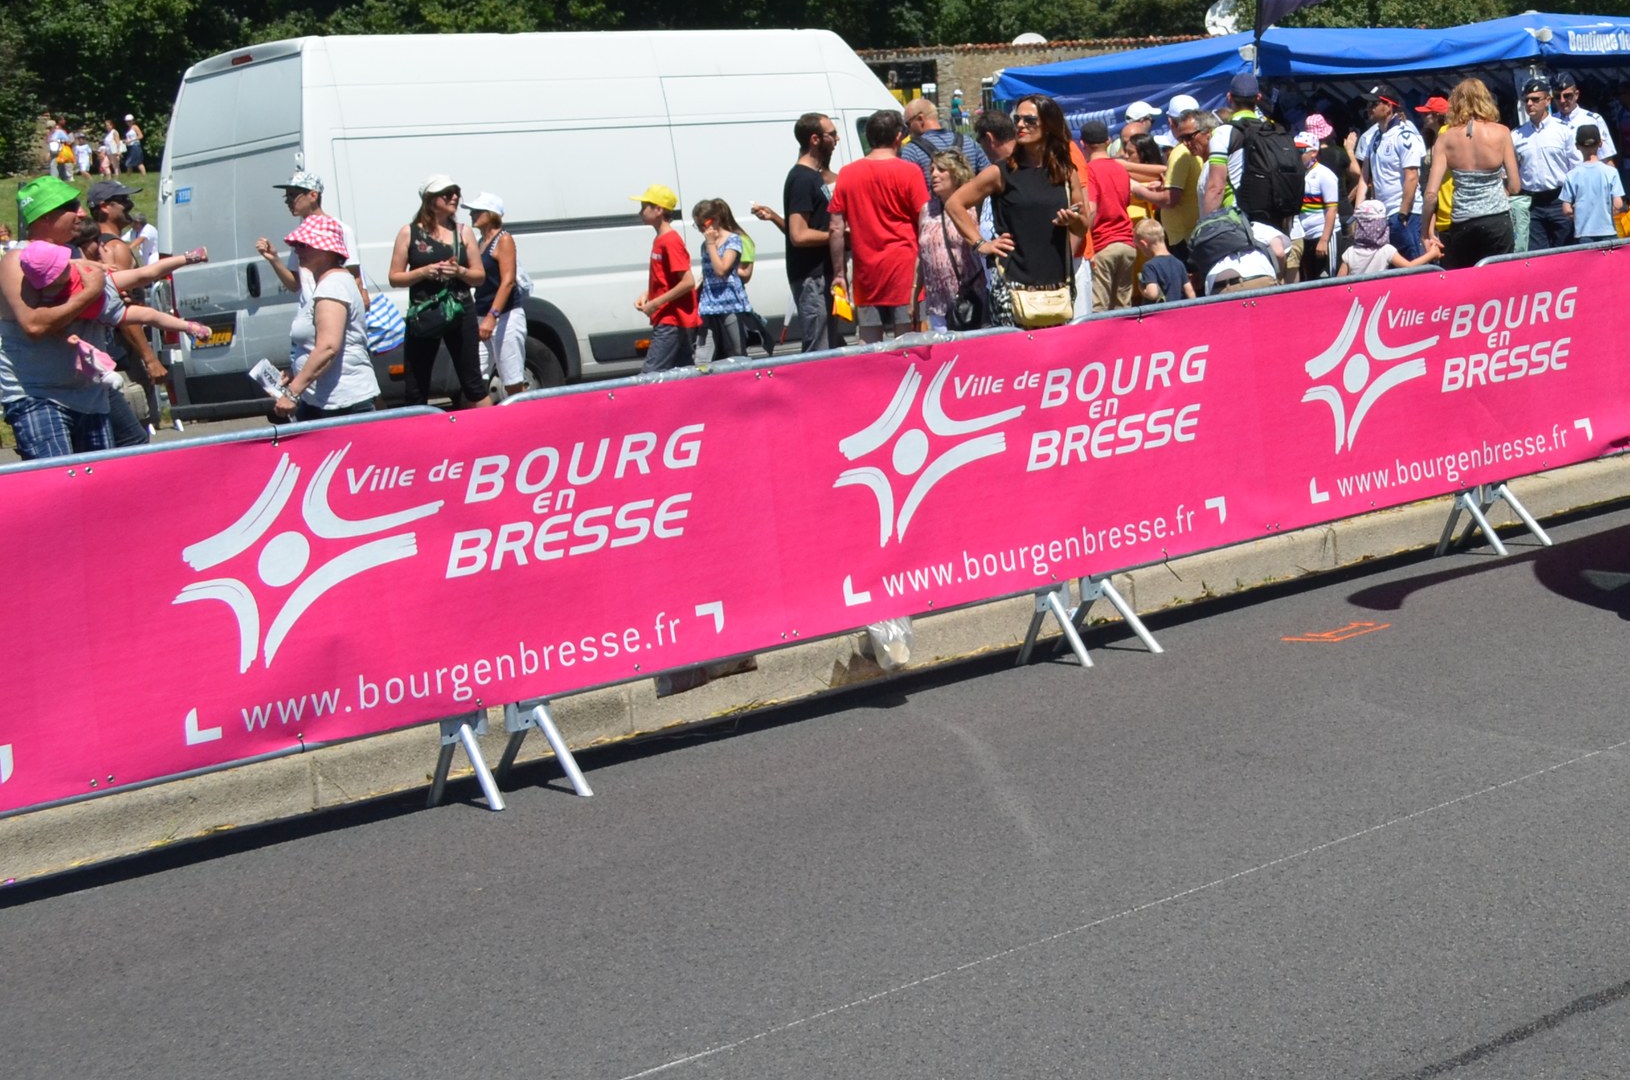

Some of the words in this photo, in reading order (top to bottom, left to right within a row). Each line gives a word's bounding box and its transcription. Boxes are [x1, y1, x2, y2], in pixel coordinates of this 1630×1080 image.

[1568, 30, 1619, 54] Boutique
[1387, 307, 1425, 329] Ville
[1431, 305, 1451, 323] de
[1450, 286, 1578, 340] BOURG
[953, 373, 1005, 398] Ville
[1013, 370, 1040, 390] de
[1039, 344, 1210, 410] BOURG
[1441, 336, 1571, 394] BRESSE
[346, 463, 416, 496] Ville
[428, 458, 465, 483] de
[464, 423, 705, 504] BOURG
[1026, 403, 1201, 473] BRESSE
[1337, 424, 1567, 497] www.bourgenbresse.fr
[445, 492, 693, 579] BRESSE
[882, 505, 1195, 598] www.bourgenbresse.fr
[241, 612, 681, 732] www.bourgenbresse.fr
